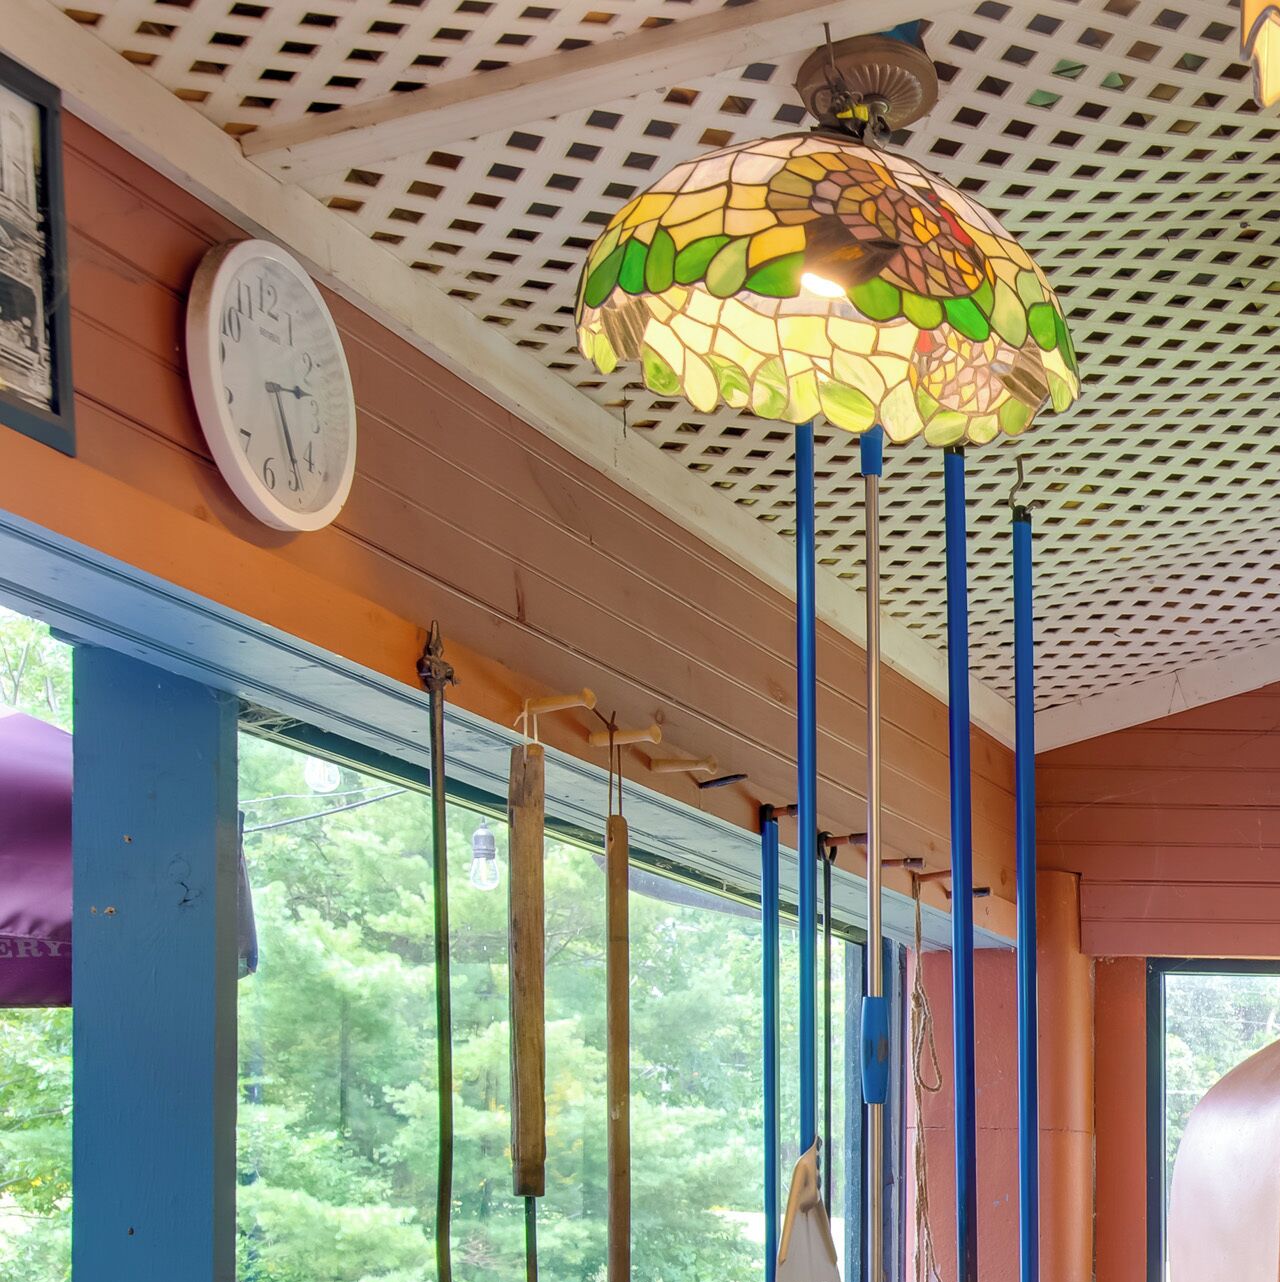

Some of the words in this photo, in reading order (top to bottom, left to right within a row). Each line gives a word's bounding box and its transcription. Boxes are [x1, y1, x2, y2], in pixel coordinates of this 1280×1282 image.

[236, 277, 253, 320] 11
[256, 275, 280, 321] 12
[302, 351, 313, 386] 2
[262, 457, 276, 490] 6
[303, 440, 315, 474] 4
